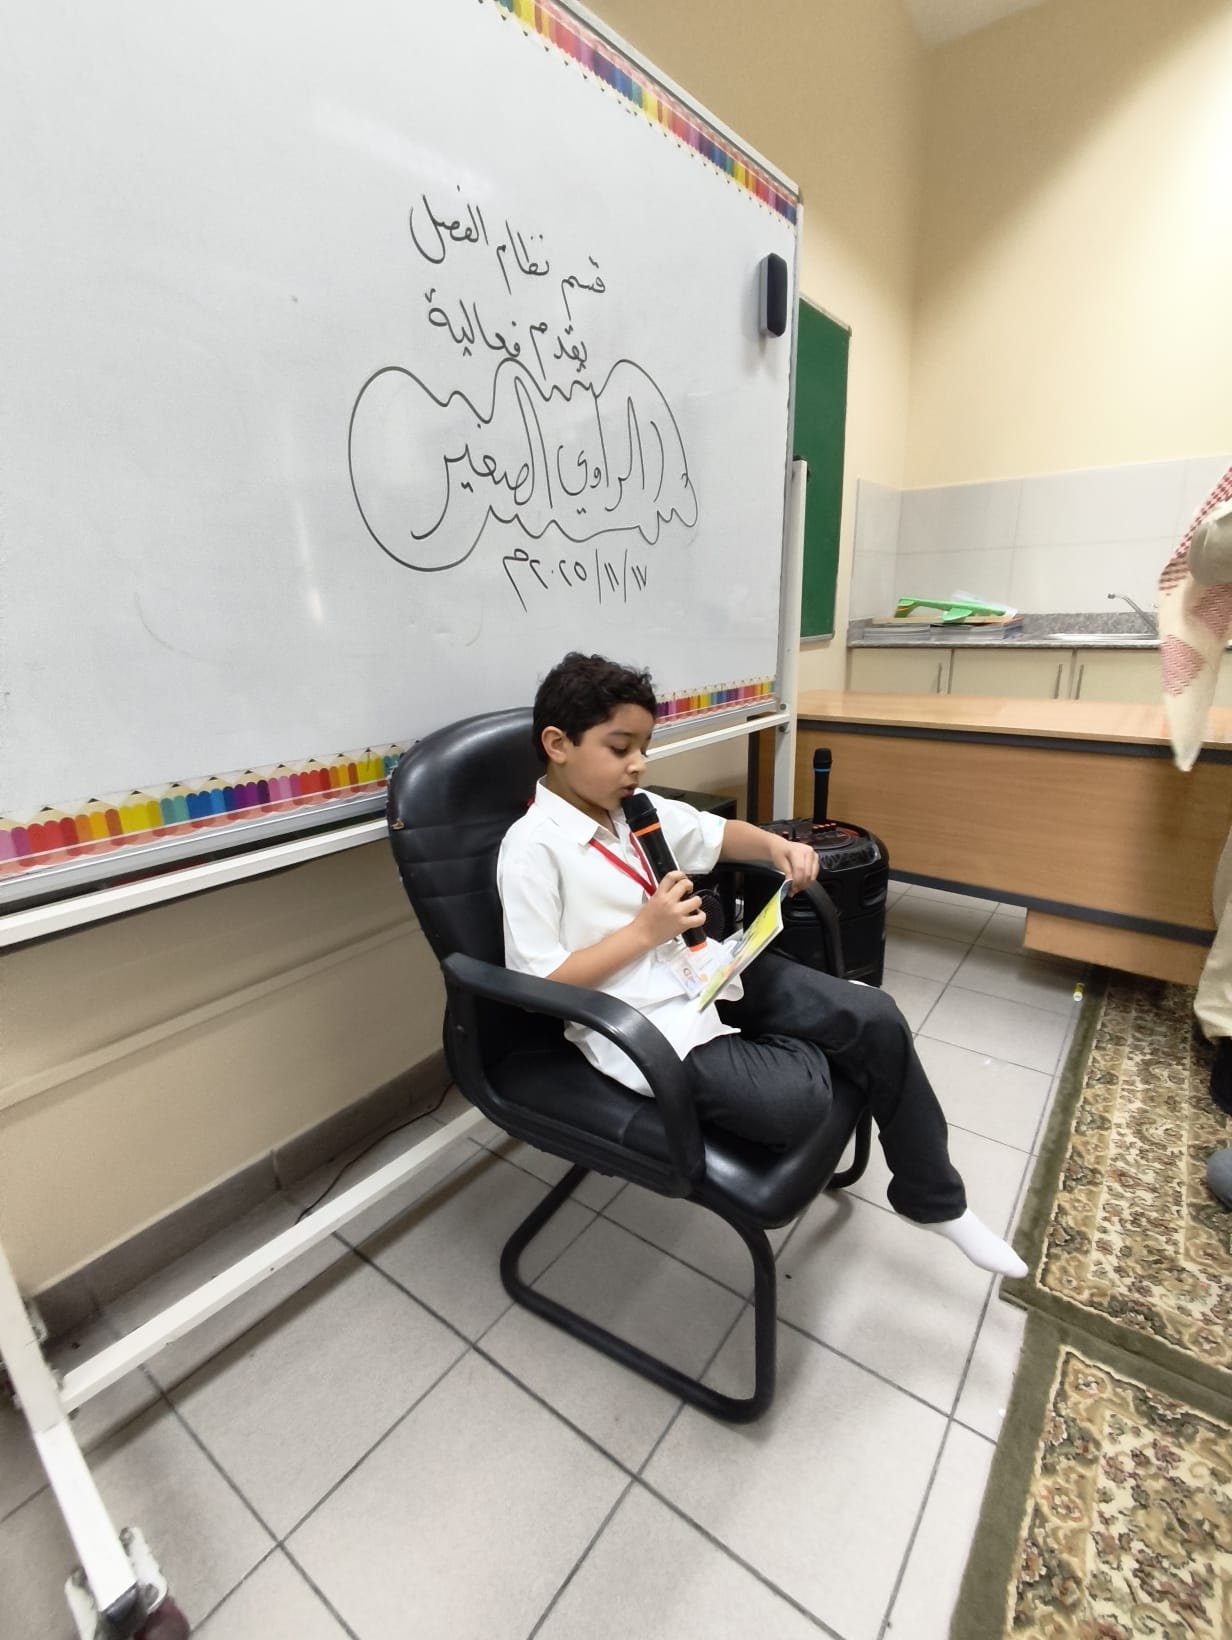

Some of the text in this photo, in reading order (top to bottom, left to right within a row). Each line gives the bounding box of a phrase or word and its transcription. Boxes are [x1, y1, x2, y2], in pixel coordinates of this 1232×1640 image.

[409, 184, 606, 321] قسم نظام الفصل
[424, 287, 521, 358] فعالية
[410, 375, 554, 541] الصغير
